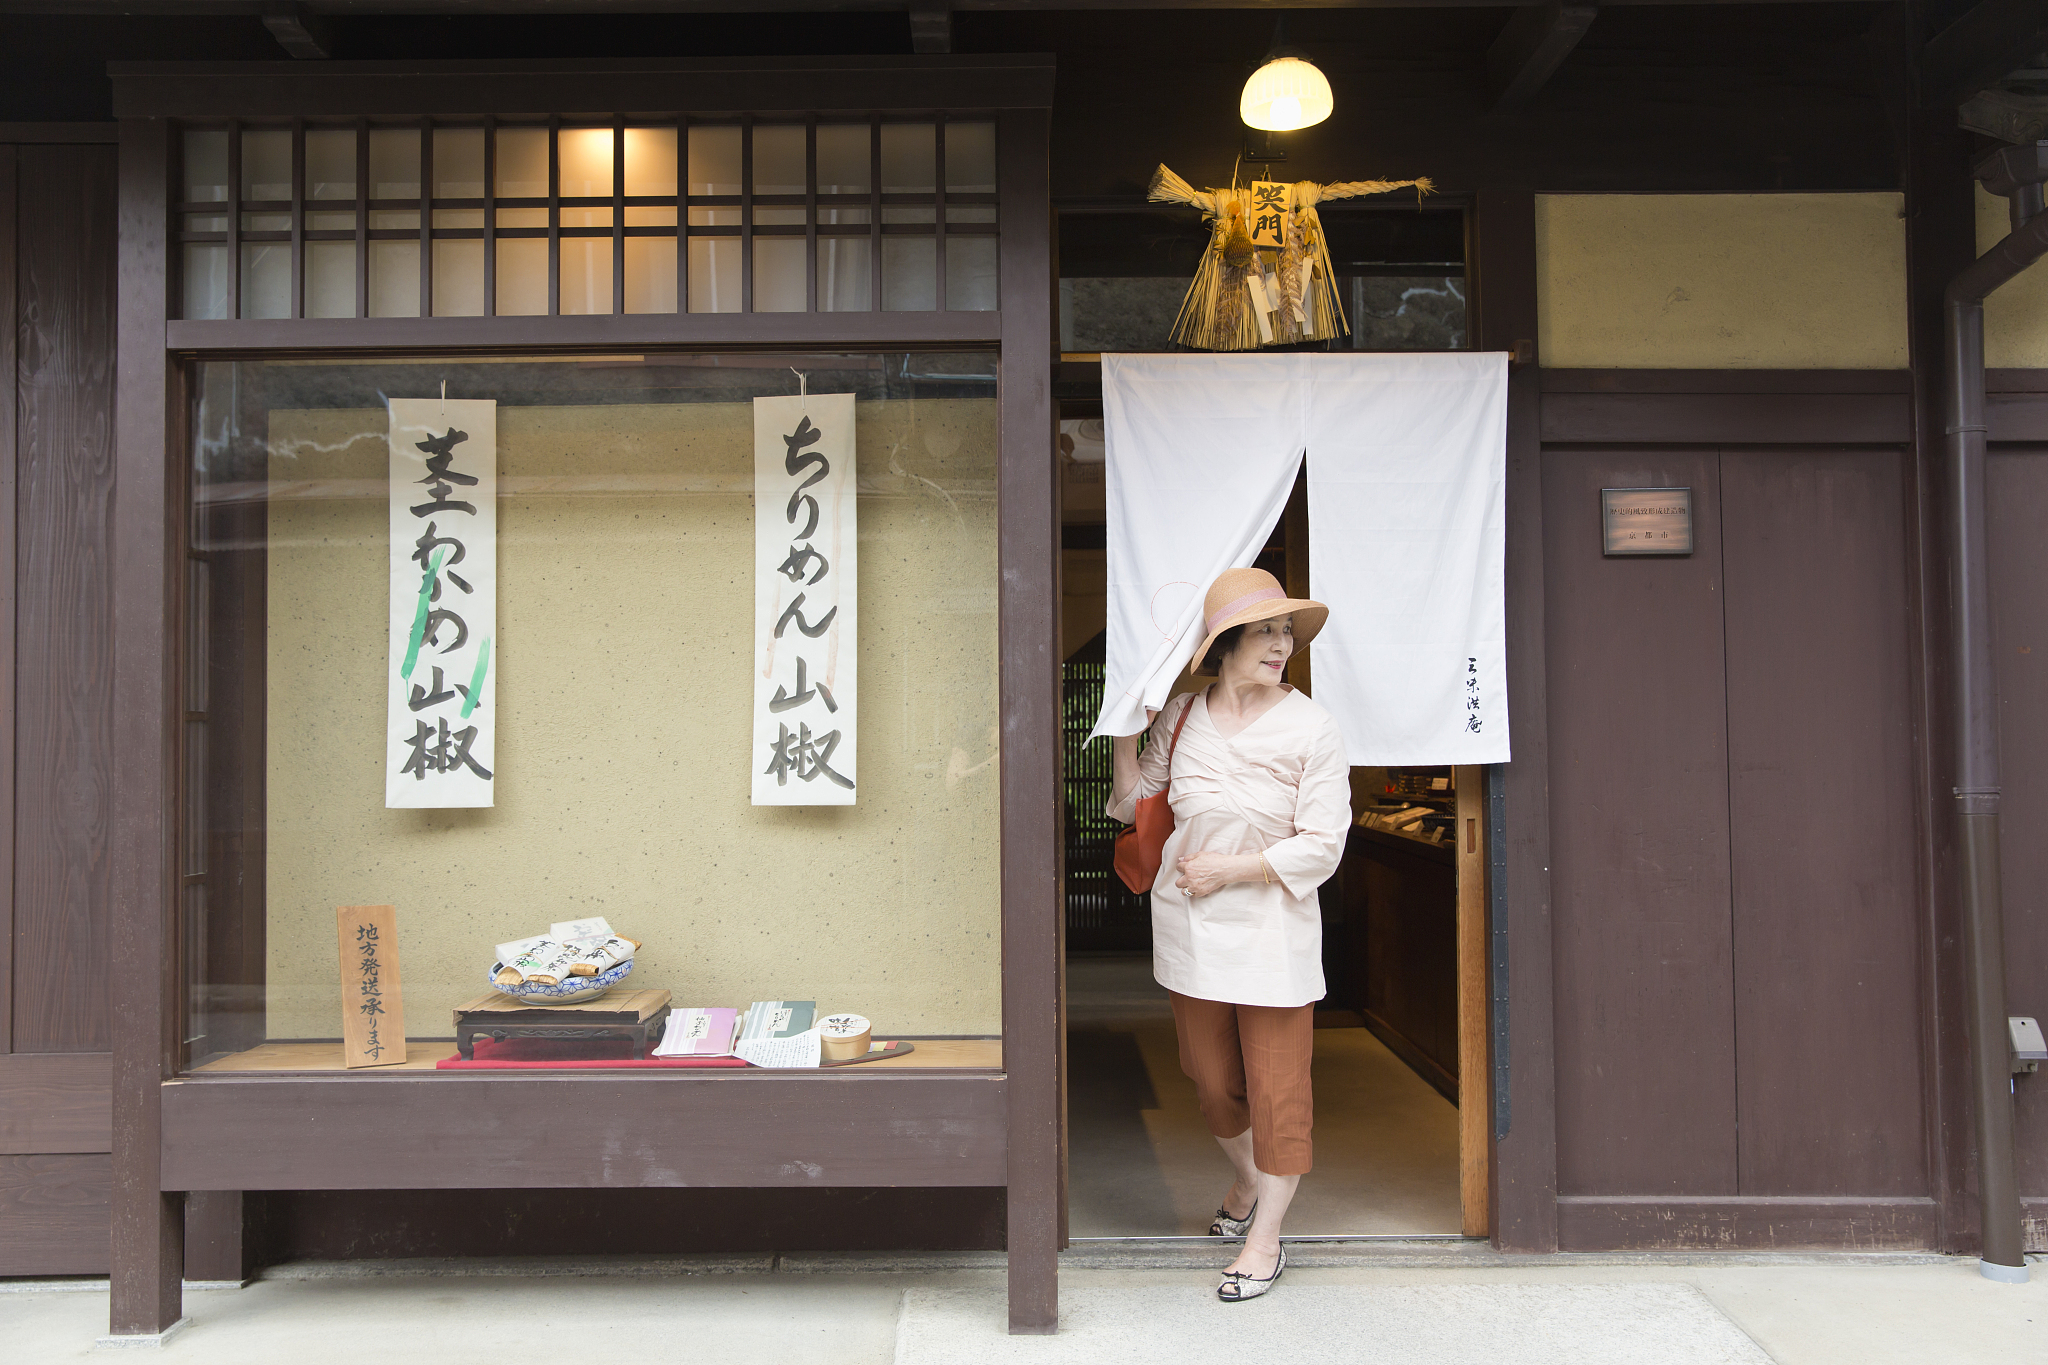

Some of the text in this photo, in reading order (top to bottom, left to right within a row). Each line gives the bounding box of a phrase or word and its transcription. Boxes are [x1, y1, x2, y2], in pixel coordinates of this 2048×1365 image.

[1252, 185, 1288, 245] 笑門
[399, 427, 493, 781] 茎わかめ山椒
[764, 415, 855, 790] ちりめん山椒
[1629, 531, 1669, 540] 京都市
[356, 923, 386, 1062] 地方発送承ります
